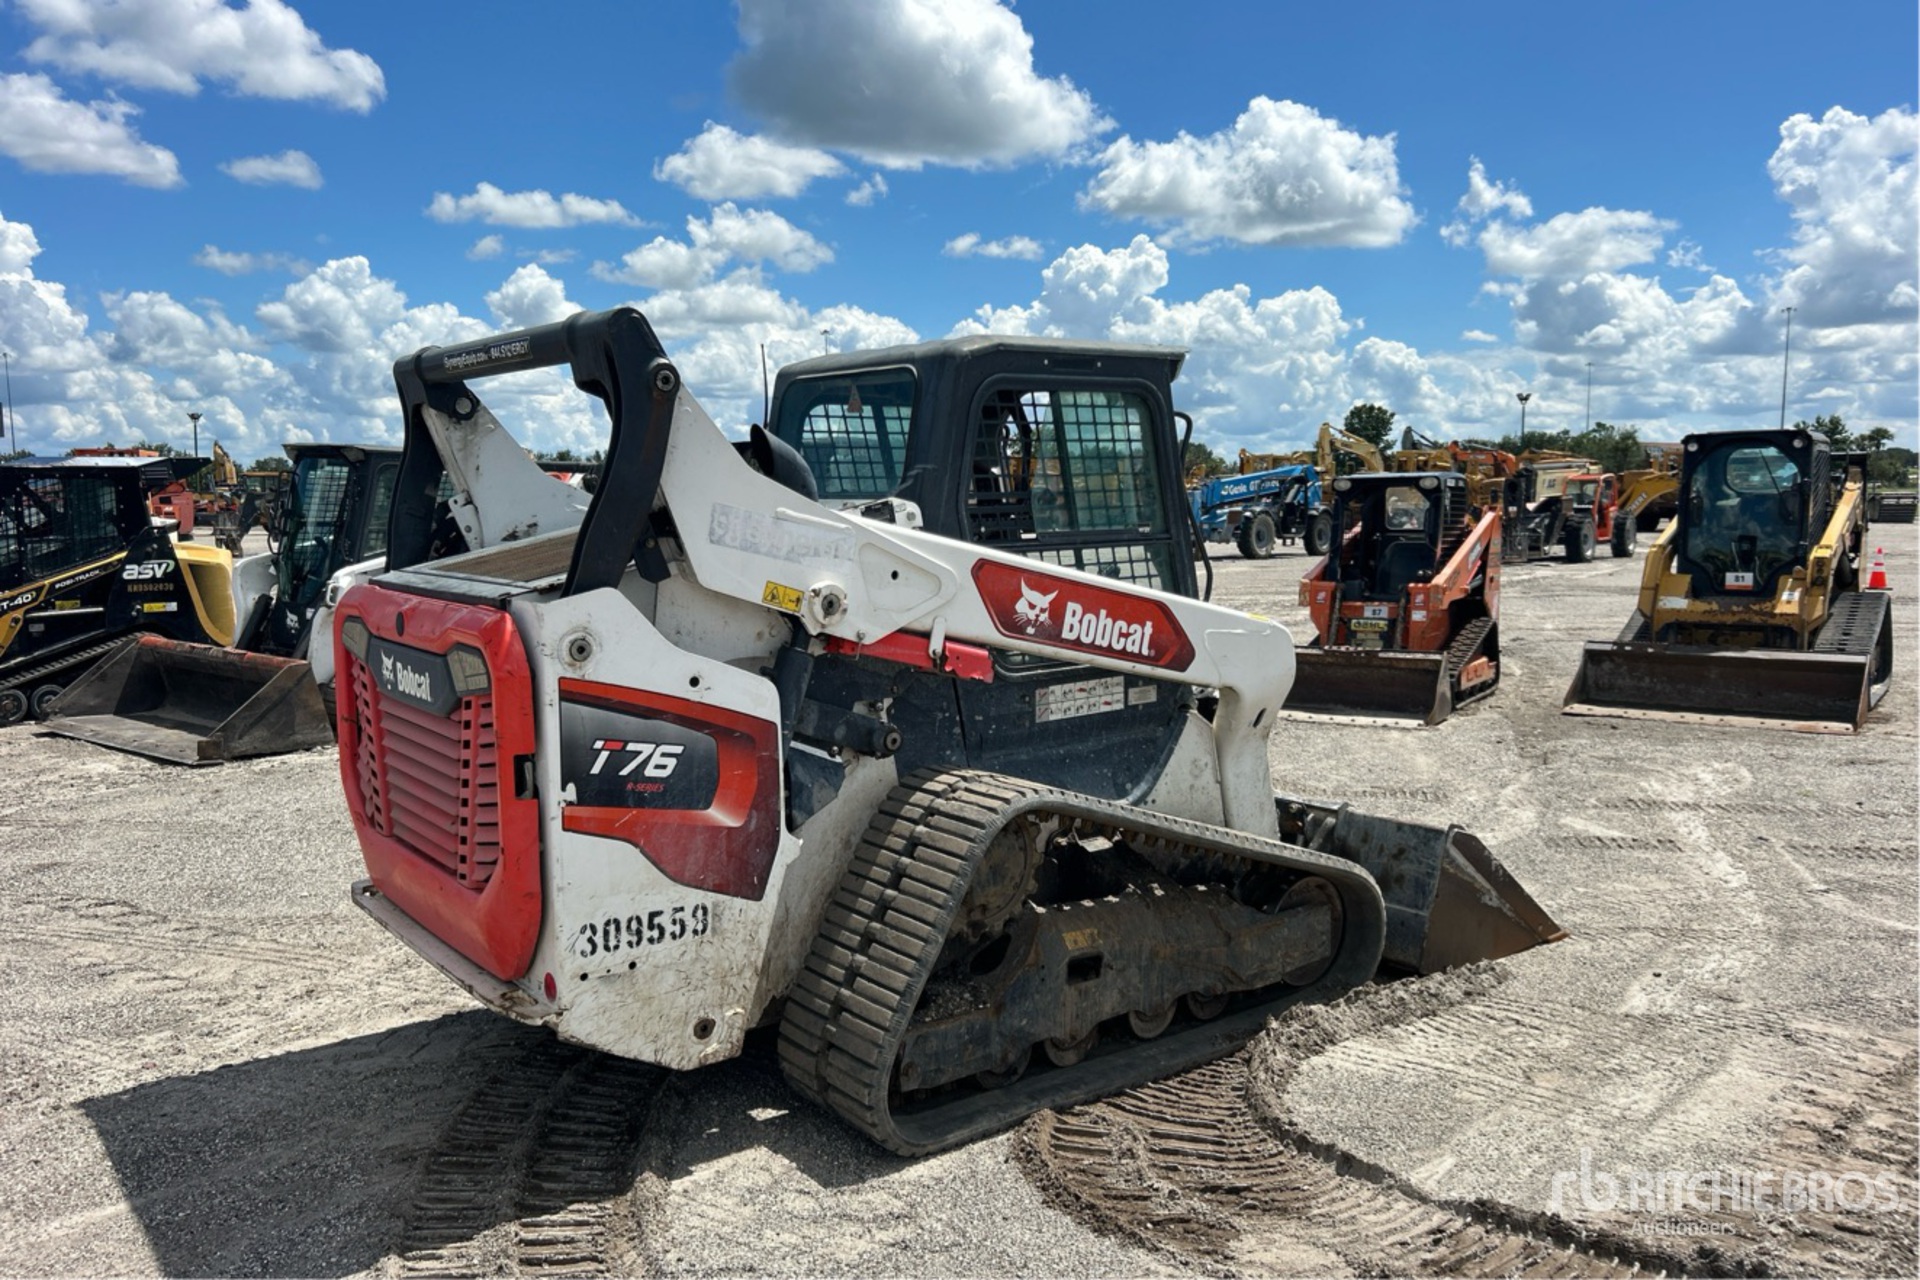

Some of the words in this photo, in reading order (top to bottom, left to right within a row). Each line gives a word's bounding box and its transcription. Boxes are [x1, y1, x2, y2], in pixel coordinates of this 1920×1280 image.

[0, 594, 32, 610] T-40
[1061, 601, 1153, 656] Bobcat
[396, 661, 432, 702] Bobcat
[589, 740, 685, 778] T76
[626, 782, 665, 793] R-SERIES
